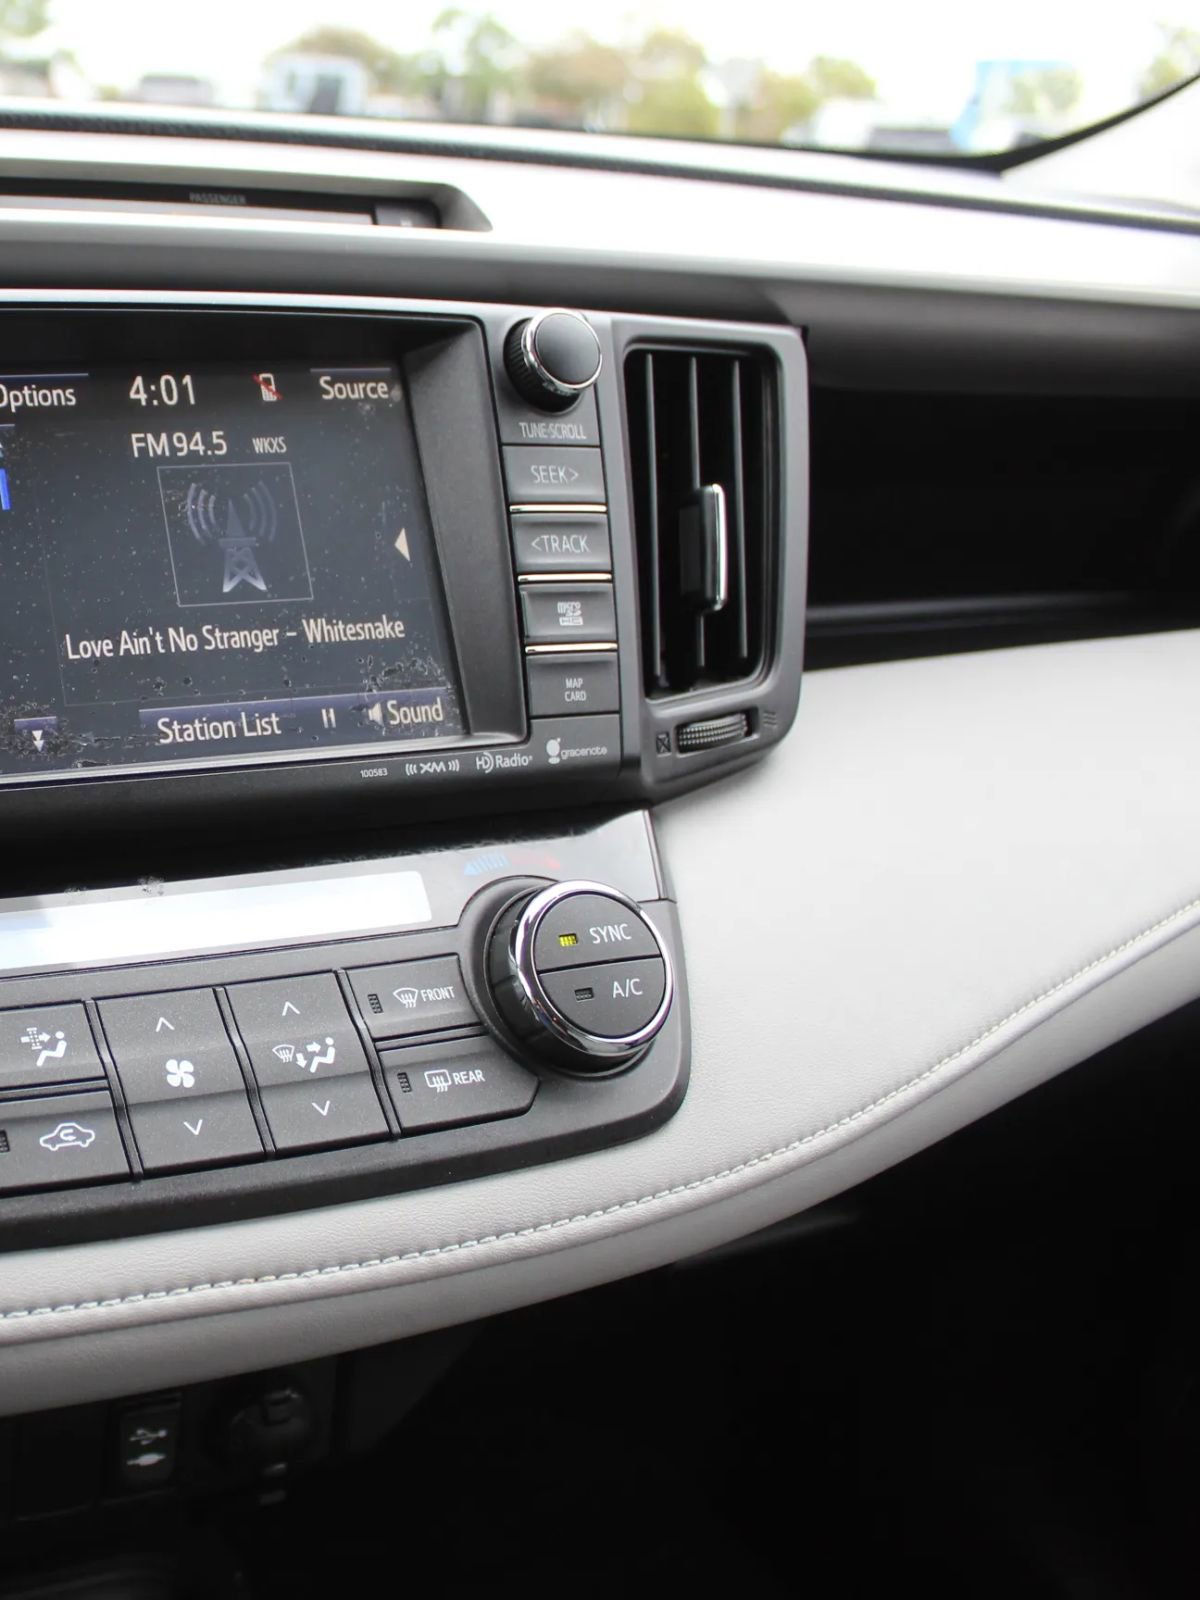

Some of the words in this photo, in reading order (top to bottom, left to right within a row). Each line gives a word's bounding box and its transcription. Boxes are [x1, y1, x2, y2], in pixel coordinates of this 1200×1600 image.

[189, 191, 246, 205] PASSENGER
[128, 374, 196, 406] 4:01
[318, 376, 390, 400] Source
[252, 436, 287, 454] WKXS
[65, 633, 114, 660] Love
[118, 629, 166, 656] Ain't
[168, 626, 198, 653] No
[201, 625, 280, 653] Stranger
[302, 614, 406, 644] Whitesnake
[565, 677, 583, 689] MAP
[564, 690, 587, 702] CARD
[386, 696, 444, 726] Sound
[156, 716, 236, 745] Station
[240, 711, 282, 738] List
[360, 767, 388, 778] 100583
[589, 922, 632, 945] SYNC
[420, 985, 455, 1003] FRONT
[612, 977, 643, 1000] A/C
[452, 1069, 486, 1085] REAR
